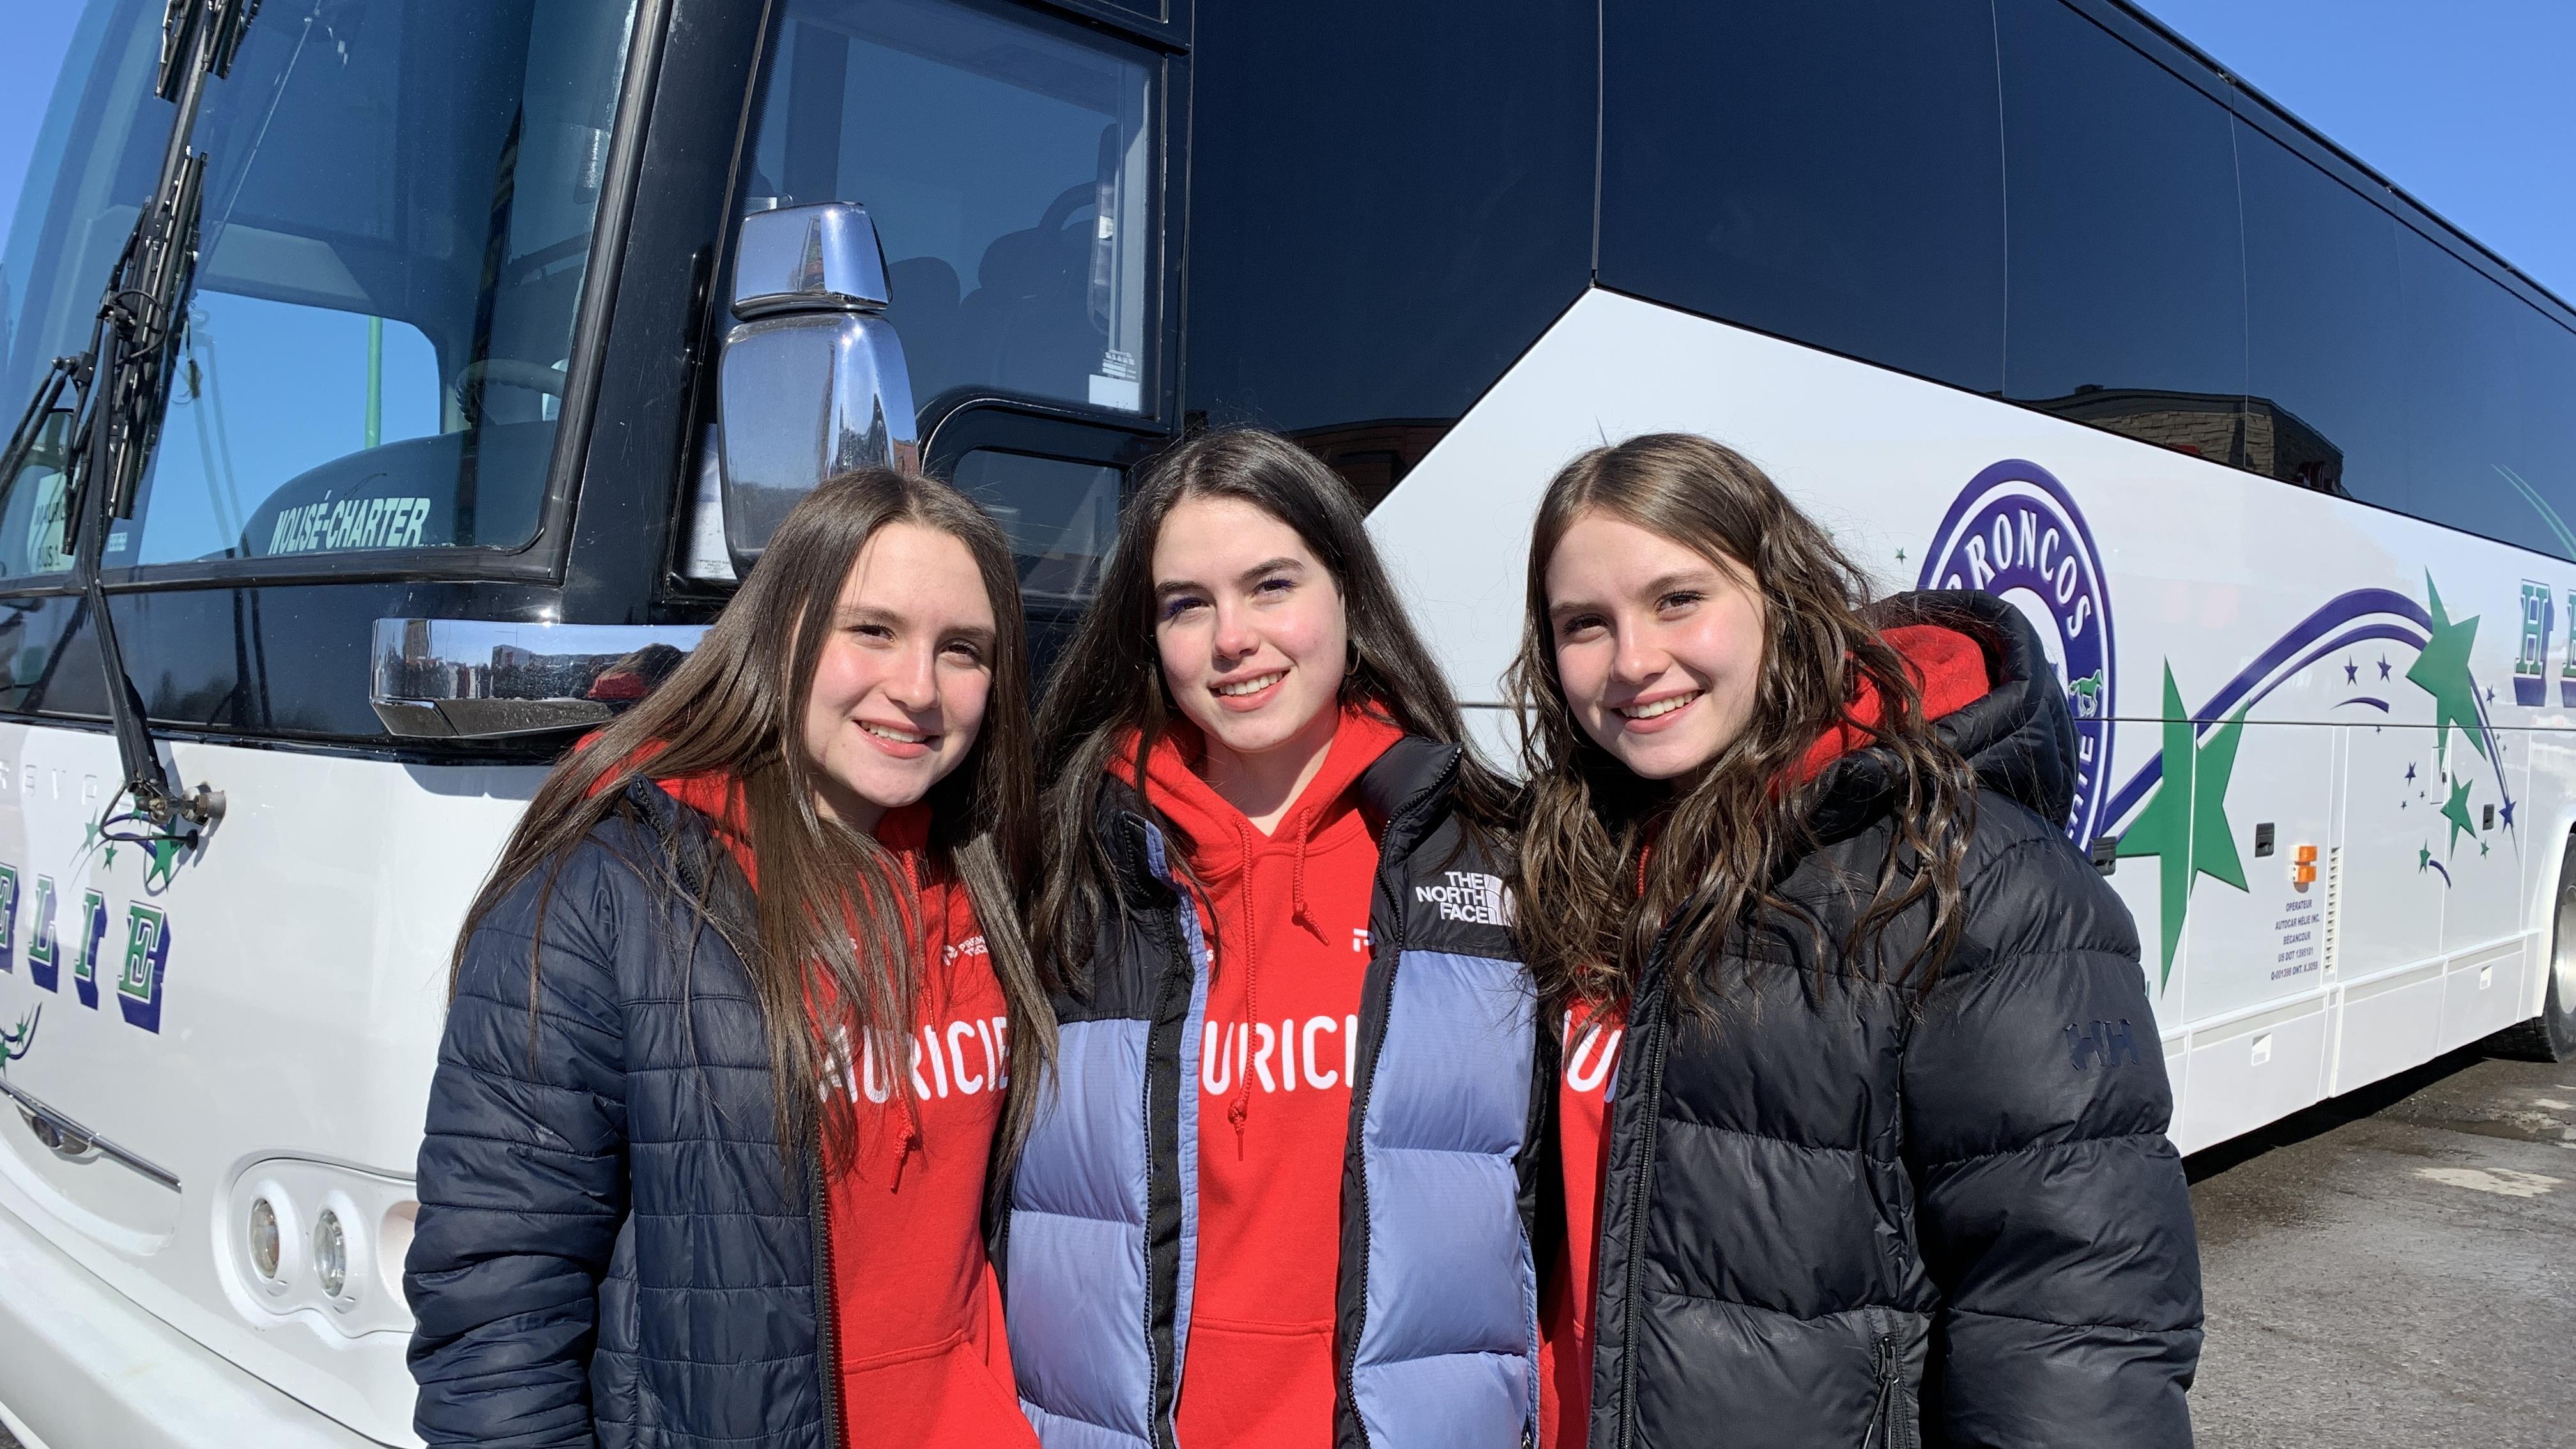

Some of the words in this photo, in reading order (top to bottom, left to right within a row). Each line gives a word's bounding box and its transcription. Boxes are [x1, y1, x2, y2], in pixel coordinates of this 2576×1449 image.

[268, 489, 431, 555] NOLISÉ-CHARTER
[1445, 871, 1485, 890] THE
[1415, 886, 1486, 907] NORTH
[1440, 902, 1489, 924] FACE
[2275, 918, 2297, 930] AUTOCAR
[2285, 950, 2295, 961] DOT
[1202, 1014, 1358, 1096] URICI
